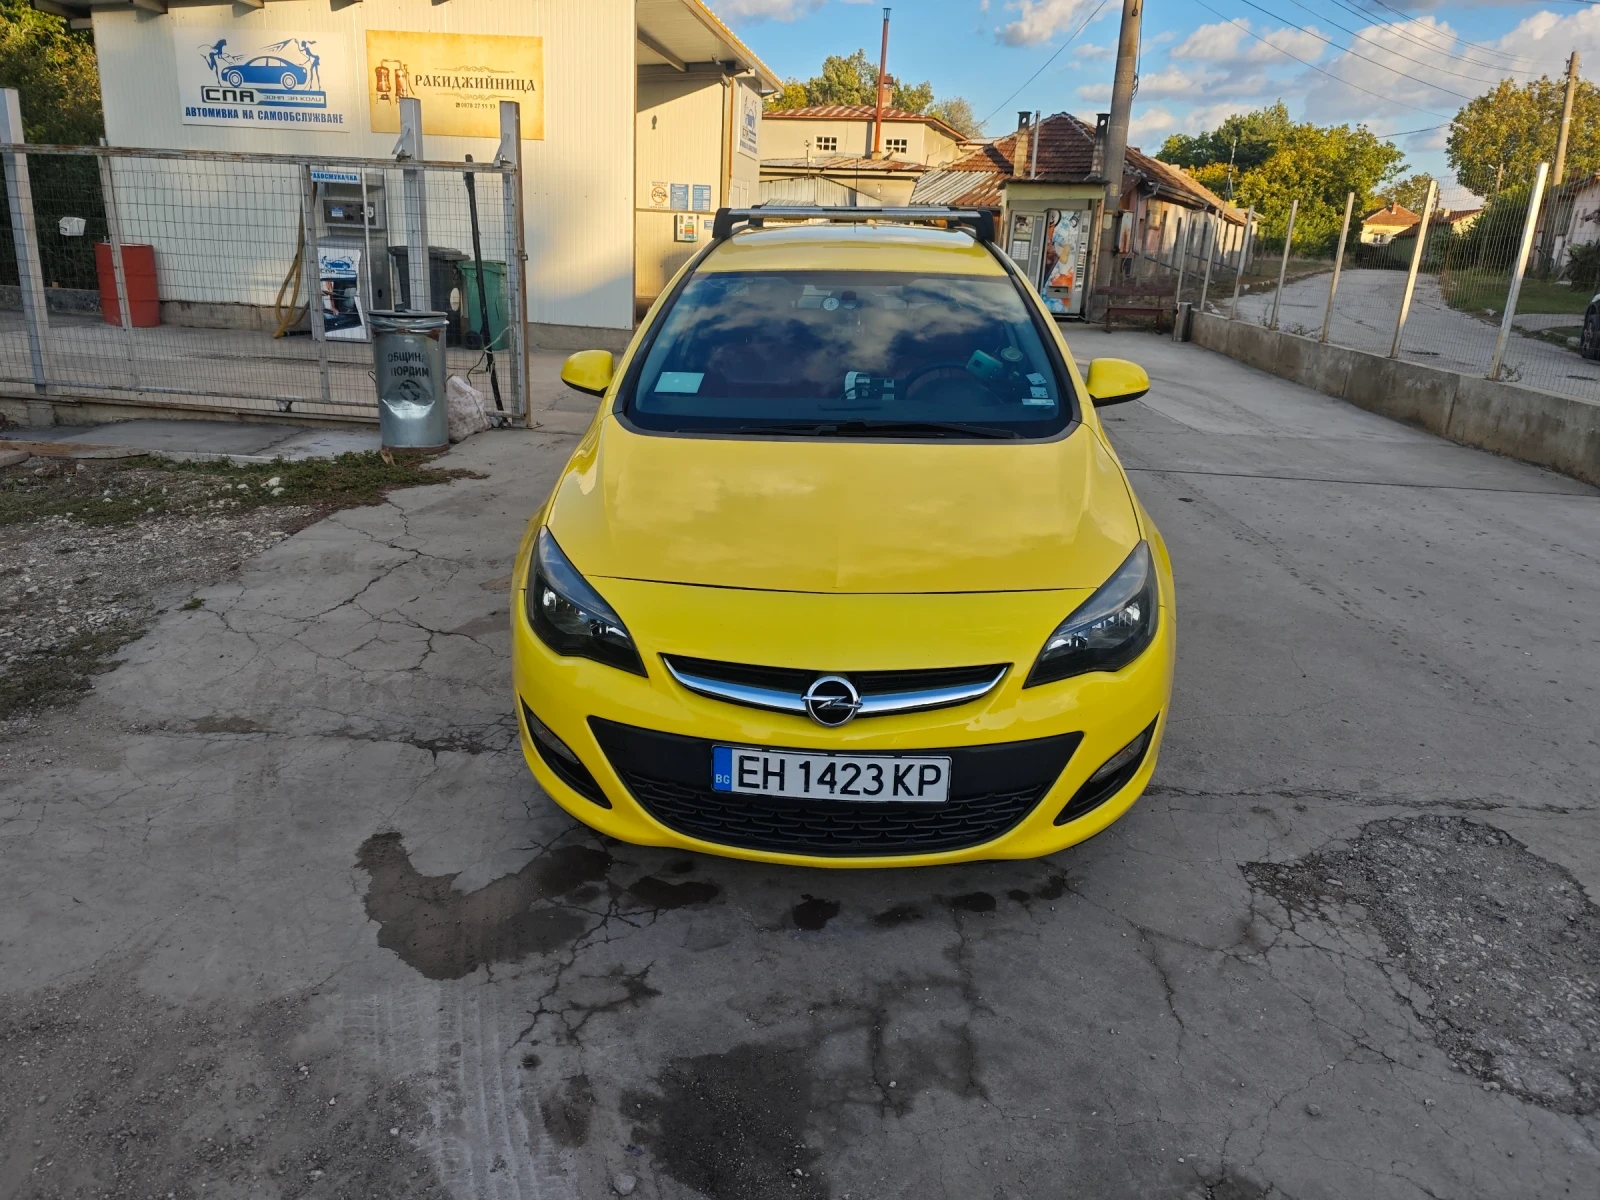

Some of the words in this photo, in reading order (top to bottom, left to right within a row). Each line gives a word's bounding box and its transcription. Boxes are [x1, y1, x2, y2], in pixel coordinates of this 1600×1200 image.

[415, 75, 536, 94] РАКИДЖИЙНИЦА
[205, 88, 255, 103] СПА
[185, 106, 239, 119] АВТОМИВКА
[242, 109, 254, 120] НА
[257, 110, 344, 124] САМООБСЛУЖВАНЕ
[310, 172, 358, 181] АХОСМУКАЧКА
[387, 351, 425, 363] ОБЩИН
[390, 365, 430, 378] ПОРДИМ
[715, 773, 730, 784] BG
[738, 755, 785, 791] EH
[799, 760, 884, 796] 1423
[892, 763, 942, 796] KP
